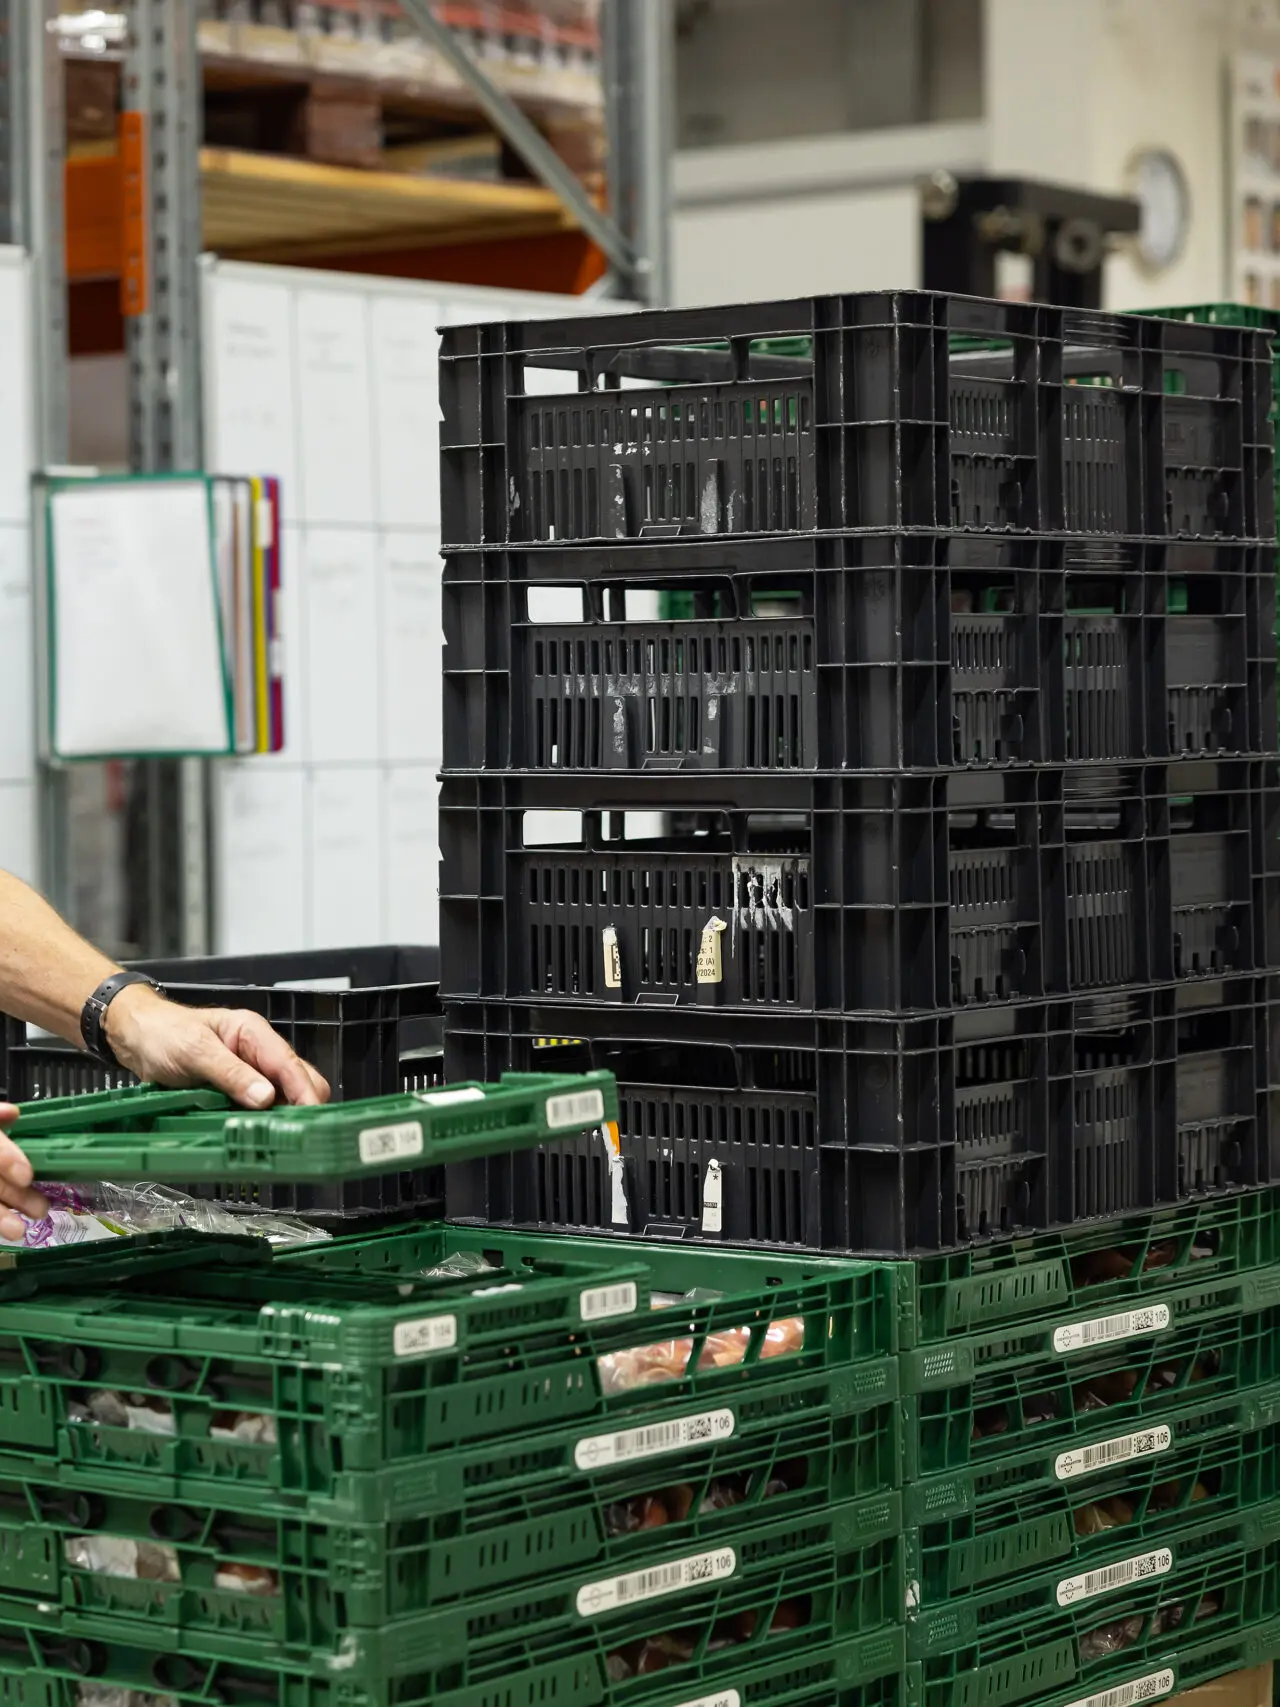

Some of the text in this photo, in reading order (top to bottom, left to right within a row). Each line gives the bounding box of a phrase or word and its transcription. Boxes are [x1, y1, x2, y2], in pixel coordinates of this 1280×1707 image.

[1155, 1309, 1167, 1323] 106
[714, 1415, 730, 1436] 106
[1156, 1431, 1169, 1445] 106
[715, 1554, 731, 1571] 106
[1157, 1554, 1170, 1568] 106
[1158, 1675, 1170, 1689] 106
